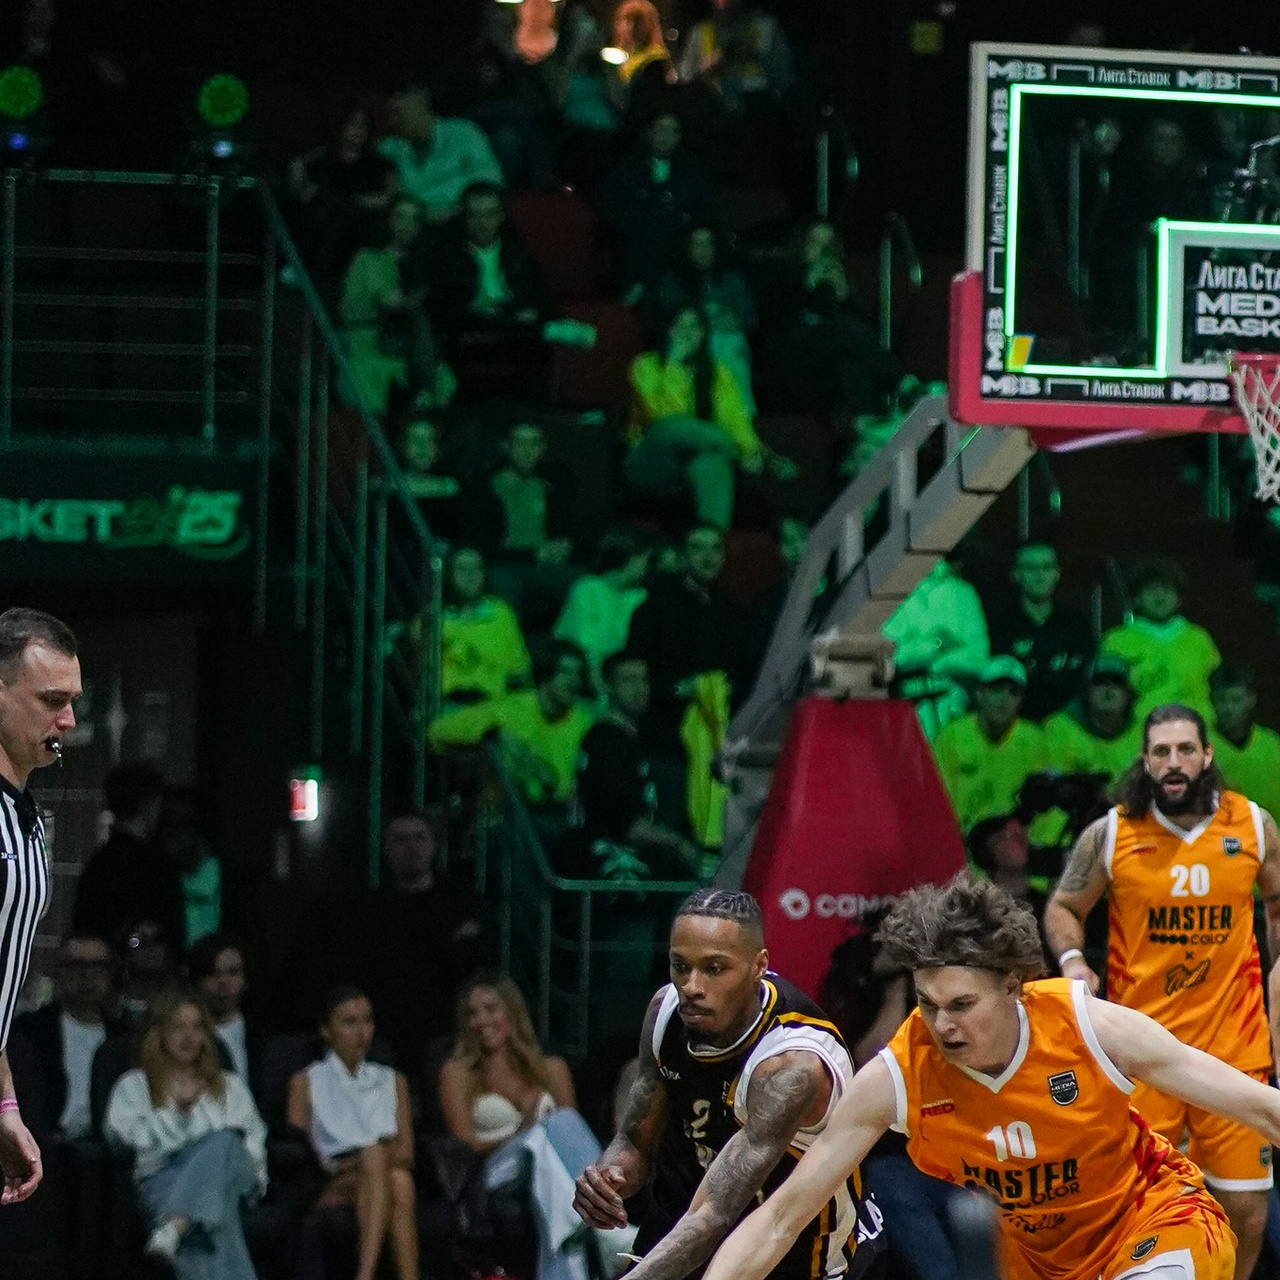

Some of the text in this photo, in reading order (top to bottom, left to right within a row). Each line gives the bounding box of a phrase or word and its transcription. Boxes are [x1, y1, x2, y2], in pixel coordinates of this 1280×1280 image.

[1169, 863, 1211, 898] 20
[1149, 904, 1233, 930] MASTER
[920, 1103, 956, 1119] RED
[985, 1120, 1038, 1163] 10
